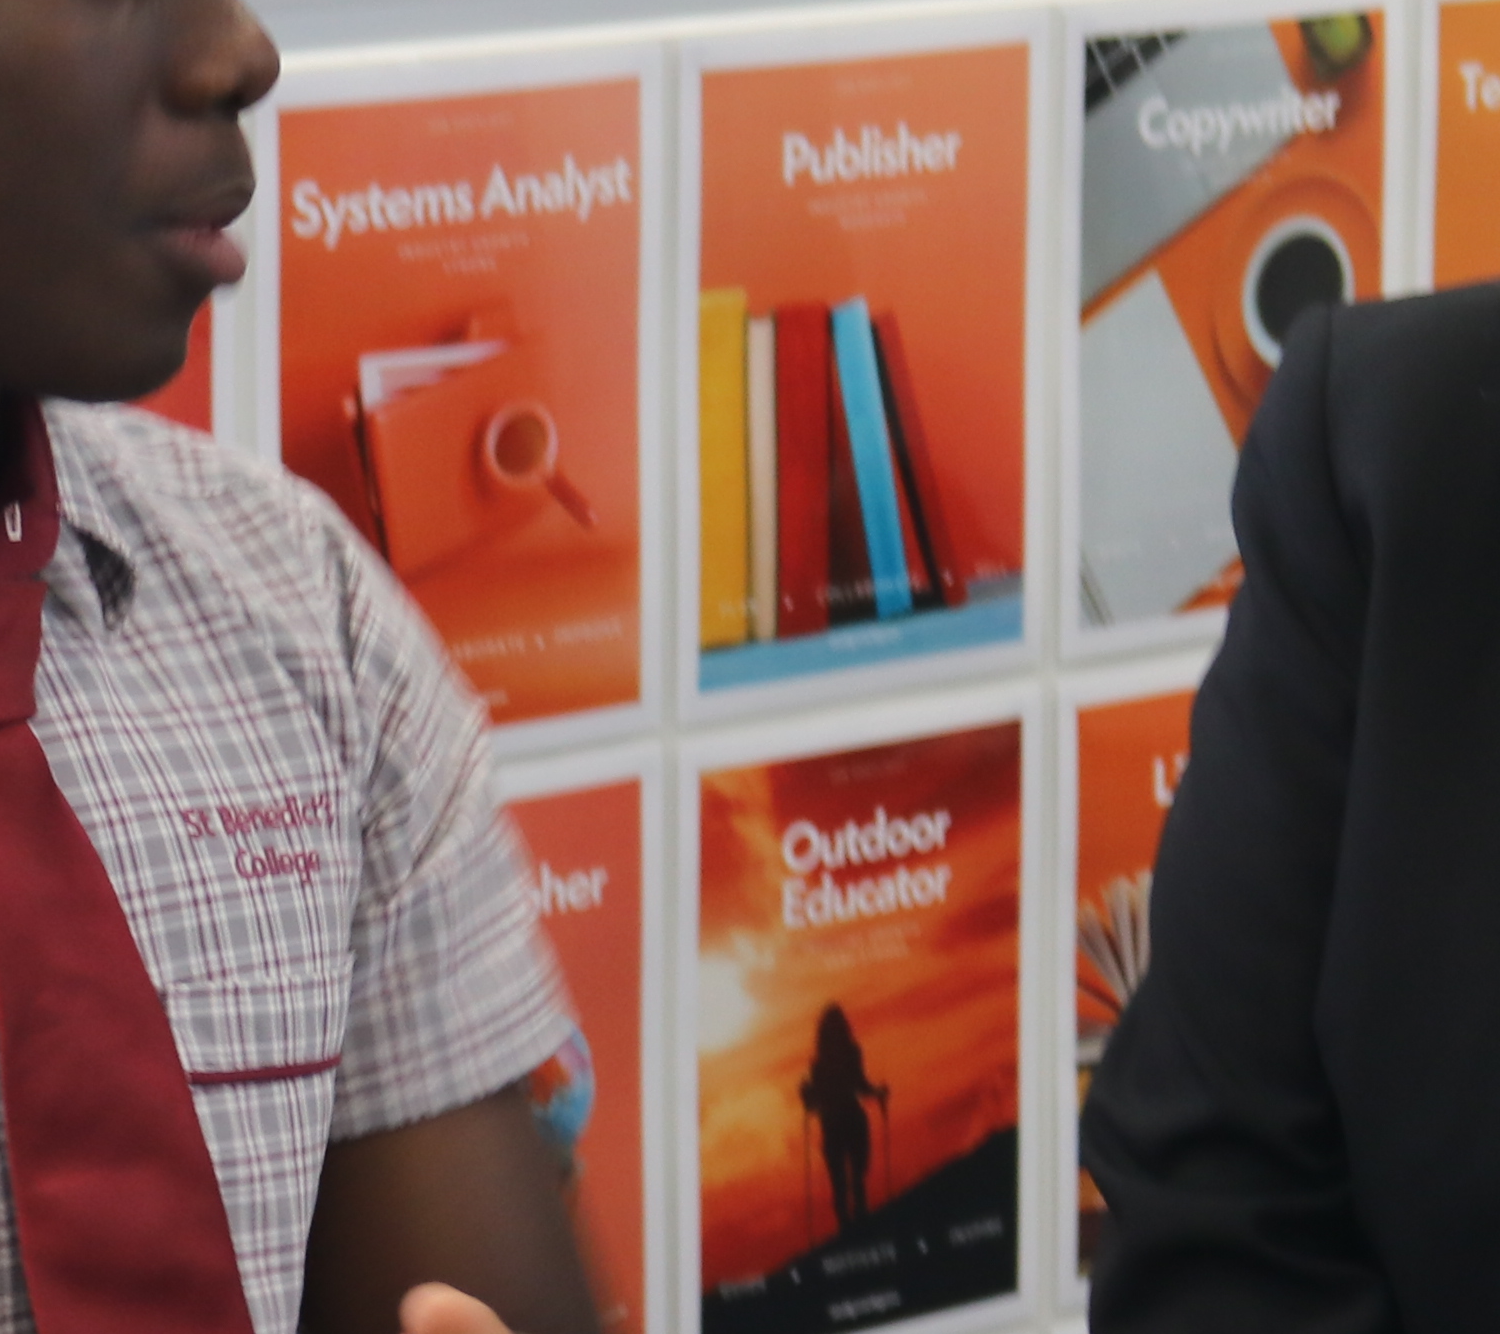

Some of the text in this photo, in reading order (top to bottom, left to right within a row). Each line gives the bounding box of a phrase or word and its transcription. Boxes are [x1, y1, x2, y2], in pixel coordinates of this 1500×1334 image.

[781, 119, 963, 189] Publisher
[1138, 82, 1342, 156] Copywriter
[289, 152, 633, 252] Systems Analyst
[235, 846, 320, 886] College
[781, 803, 953, 875] Outdoor
[530, 859, 609, 919] her
[781, 862, 953, 930] Educator
